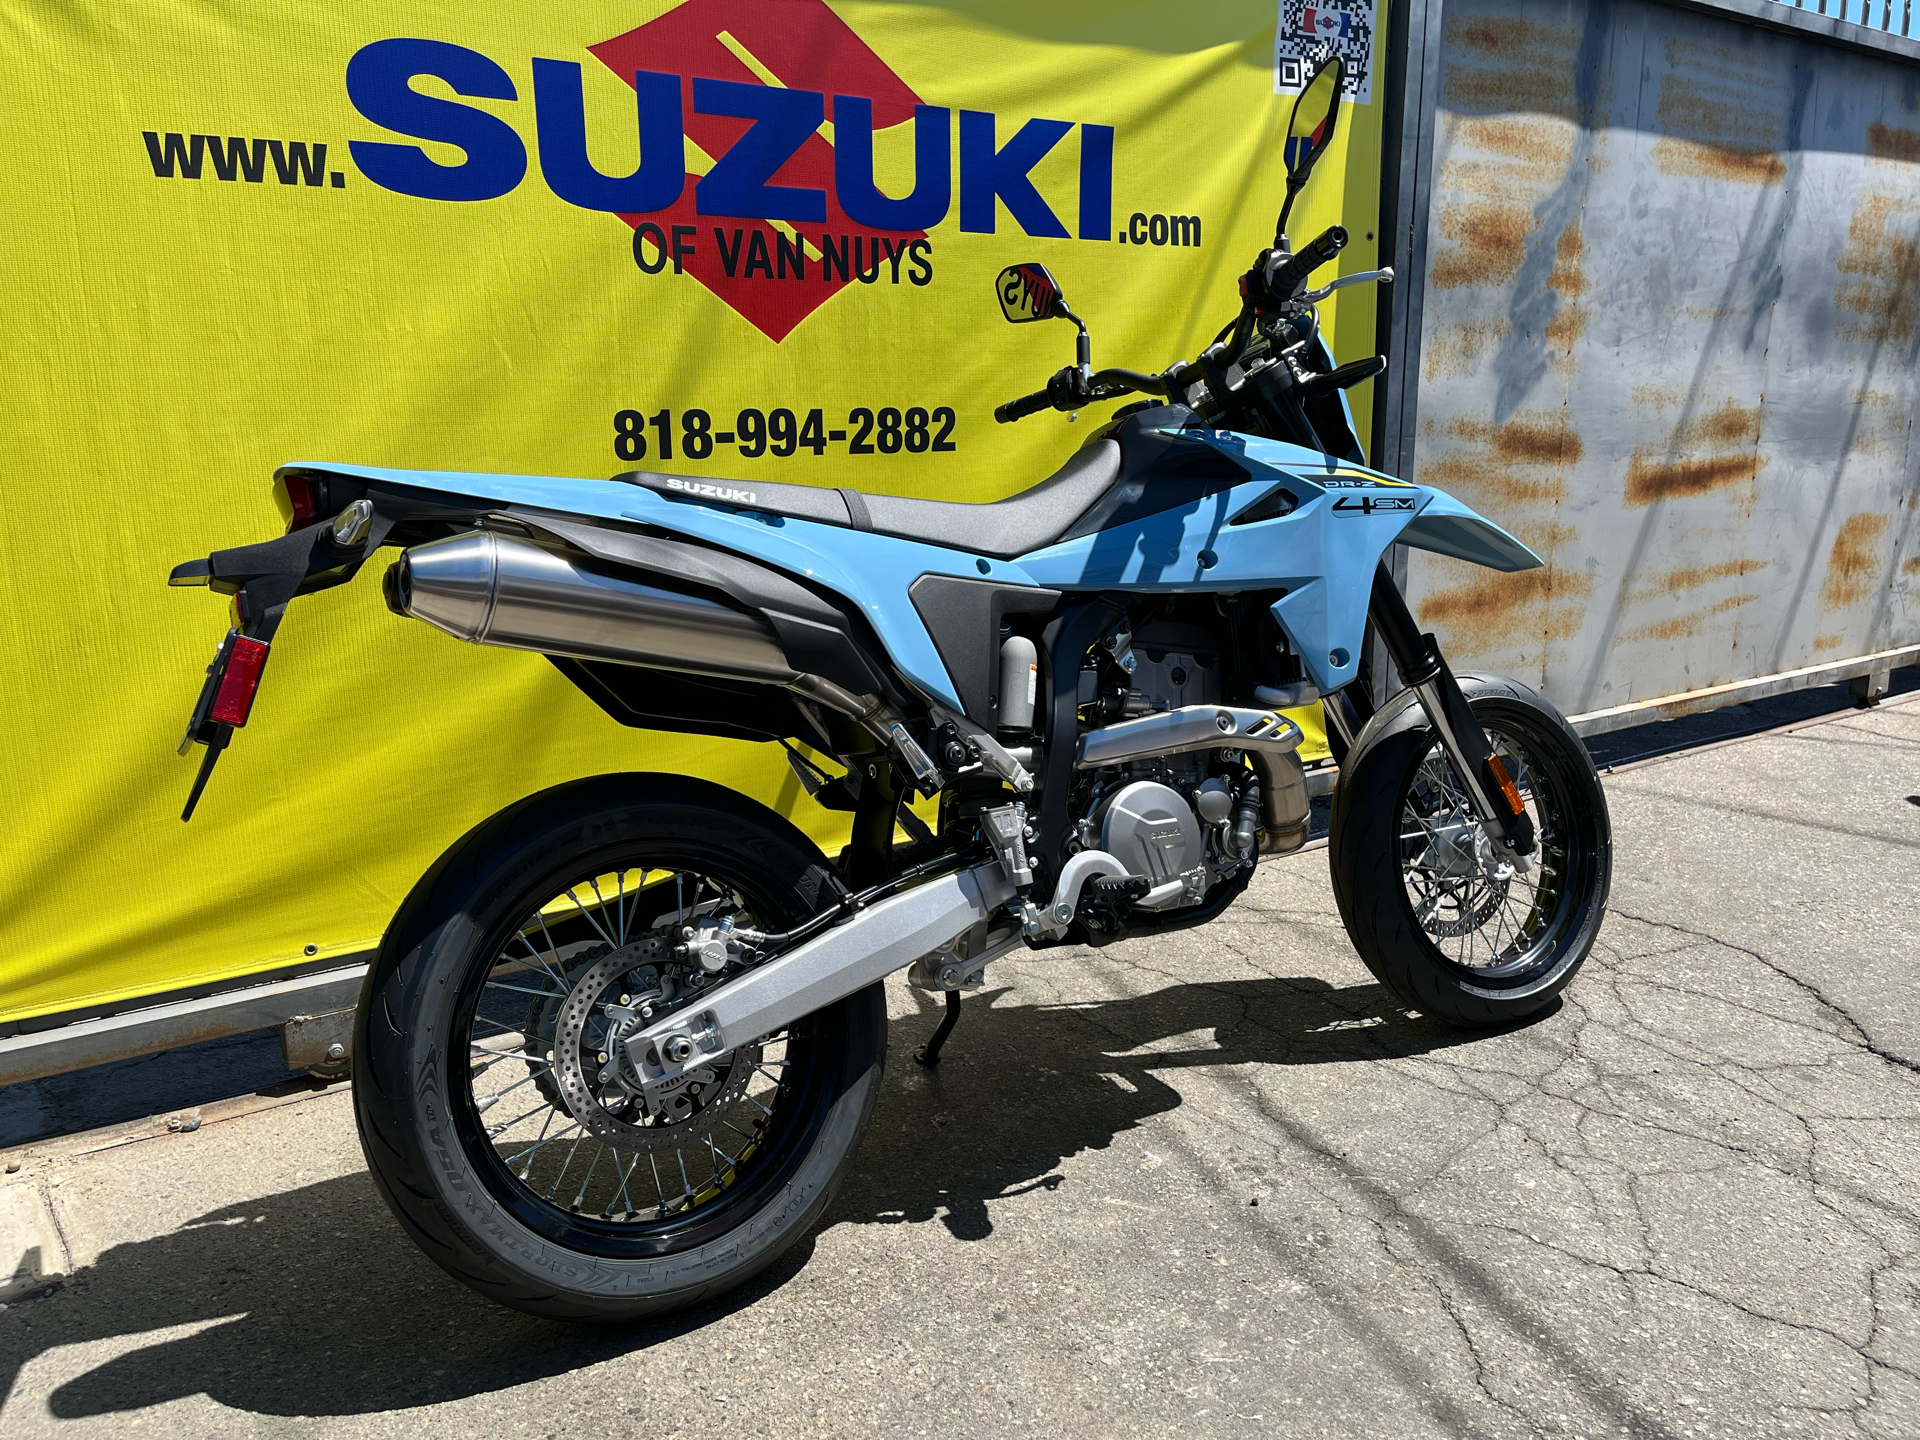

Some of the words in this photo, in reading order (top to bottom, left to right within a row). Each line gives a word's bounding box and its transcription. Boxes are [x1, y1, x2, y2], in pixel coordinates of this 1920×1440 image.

[142, 130, 346, 188] www.
[345, 37, 1115, 241] SUZUKI
[1118, 212, 1202, 248] .com
[632, 221, 697, 275] OF
[714, 226, 805, 281] VAN
[823, 233, 933, 287] NUYS
[612, 406, 957, 461] 818-994-2882
[666, 478, 757, 504] SUZUKI
[1323, 480, 1376, 488] DR-Z
